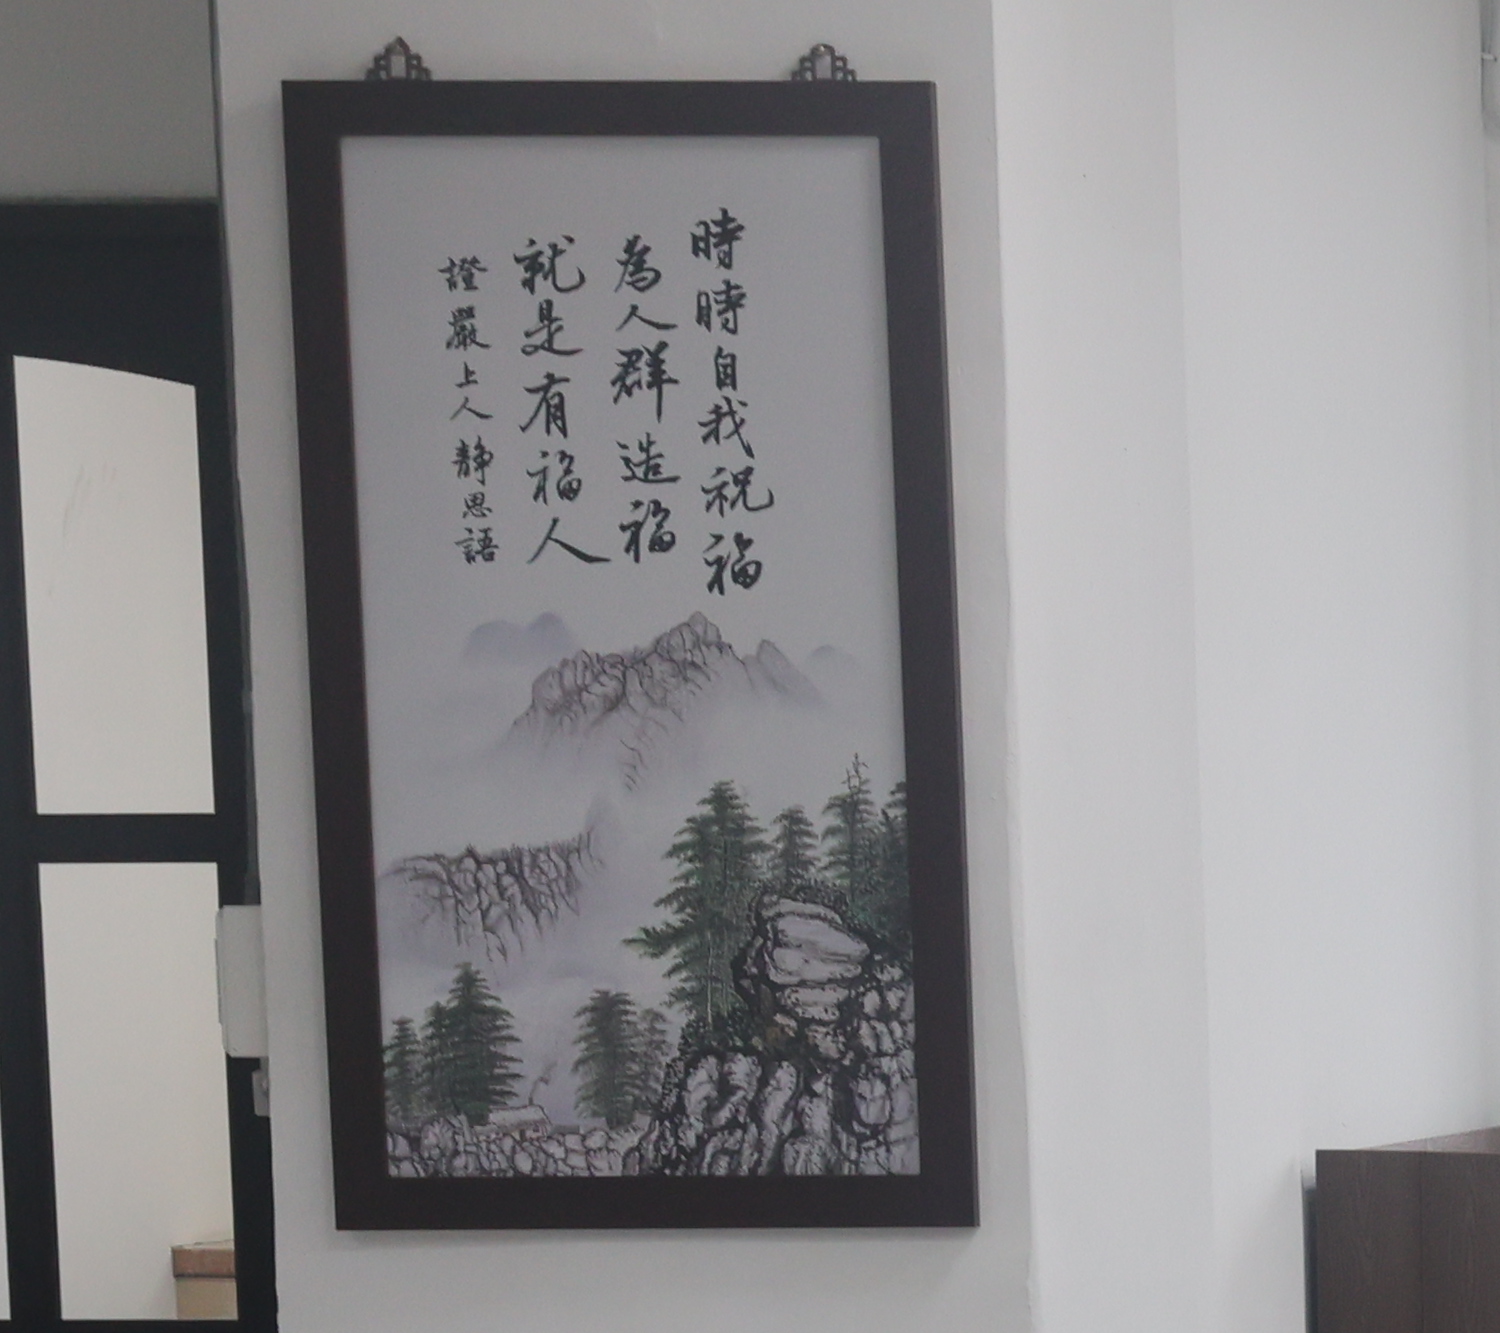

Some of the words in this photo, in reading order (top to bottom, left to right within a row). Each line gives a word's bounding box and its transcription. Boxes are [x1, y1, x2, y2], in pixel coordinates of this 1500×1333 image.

[513, 235, 612, 565] 就是有福人
[690, 207, 775, 597] 時時自我祝福
